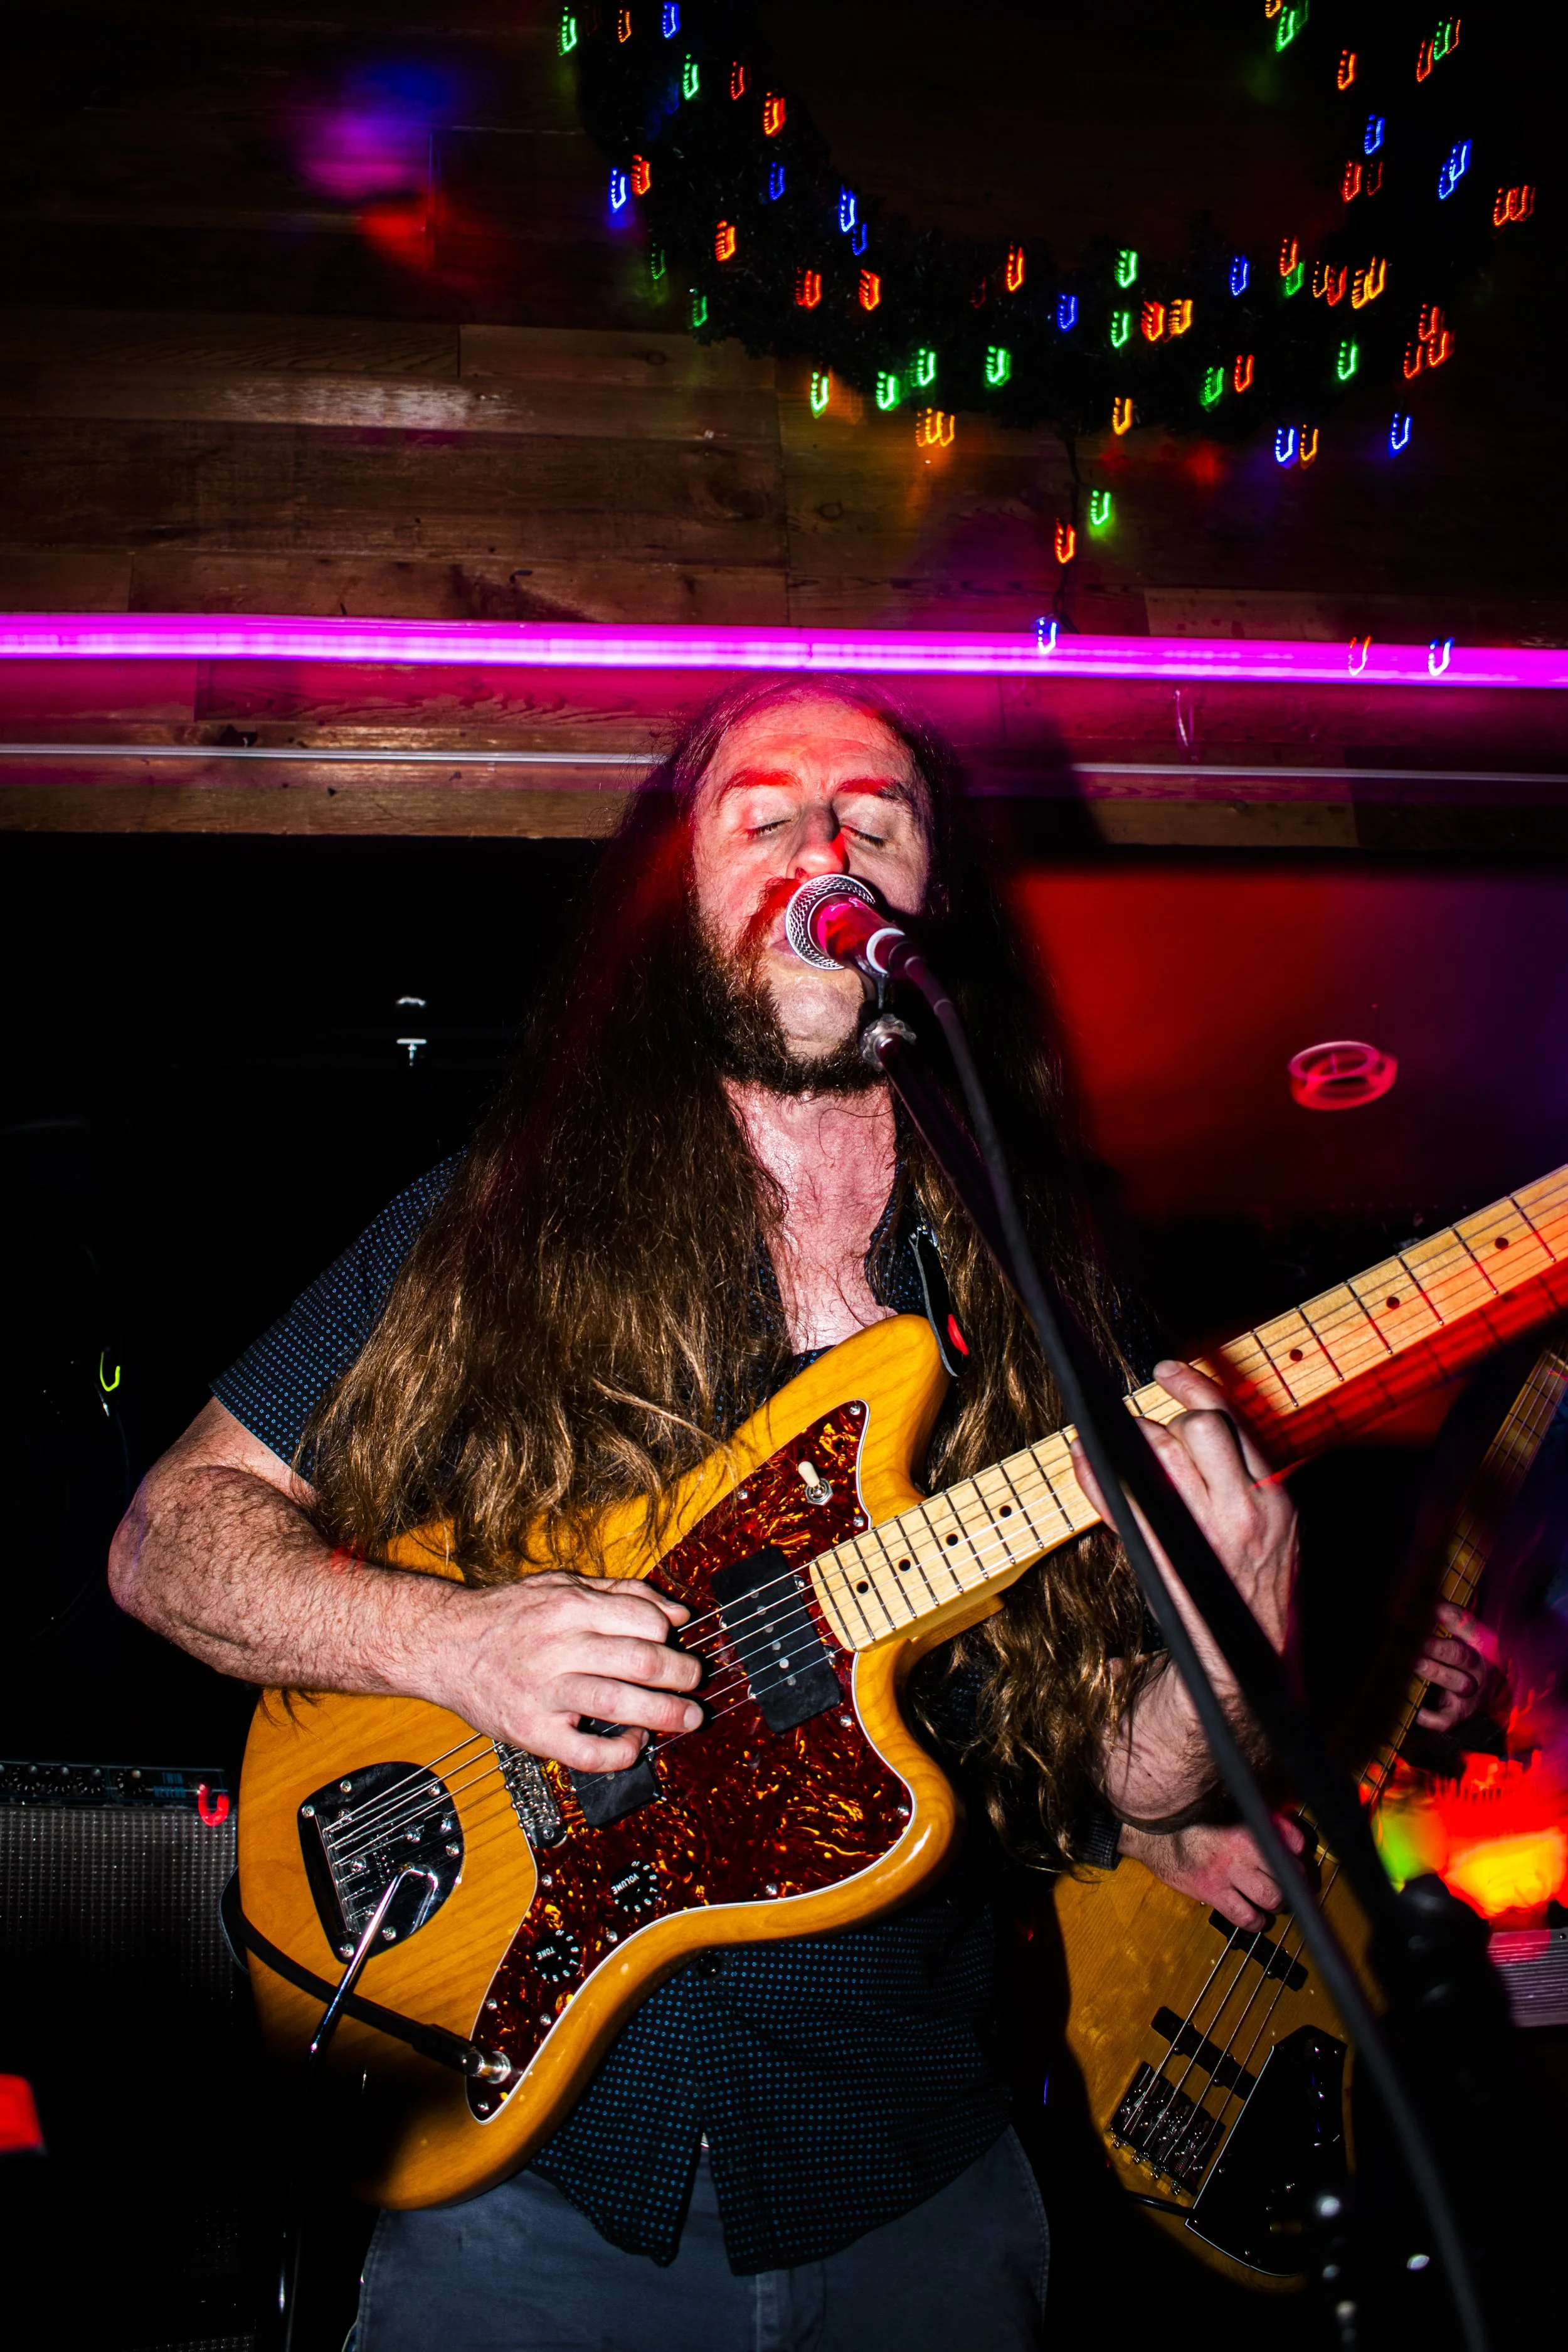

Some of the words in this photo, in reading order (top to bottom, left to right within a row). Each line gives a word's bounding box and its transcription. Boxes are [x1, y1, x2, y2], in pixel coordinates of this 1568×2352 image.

[611, 1873, 640, 1895] VOLUME
[634, 1905, 641, 1913] 5
[536, 1946, 556, 1960] TONE
[563, 1969, 570, 1978] 6
